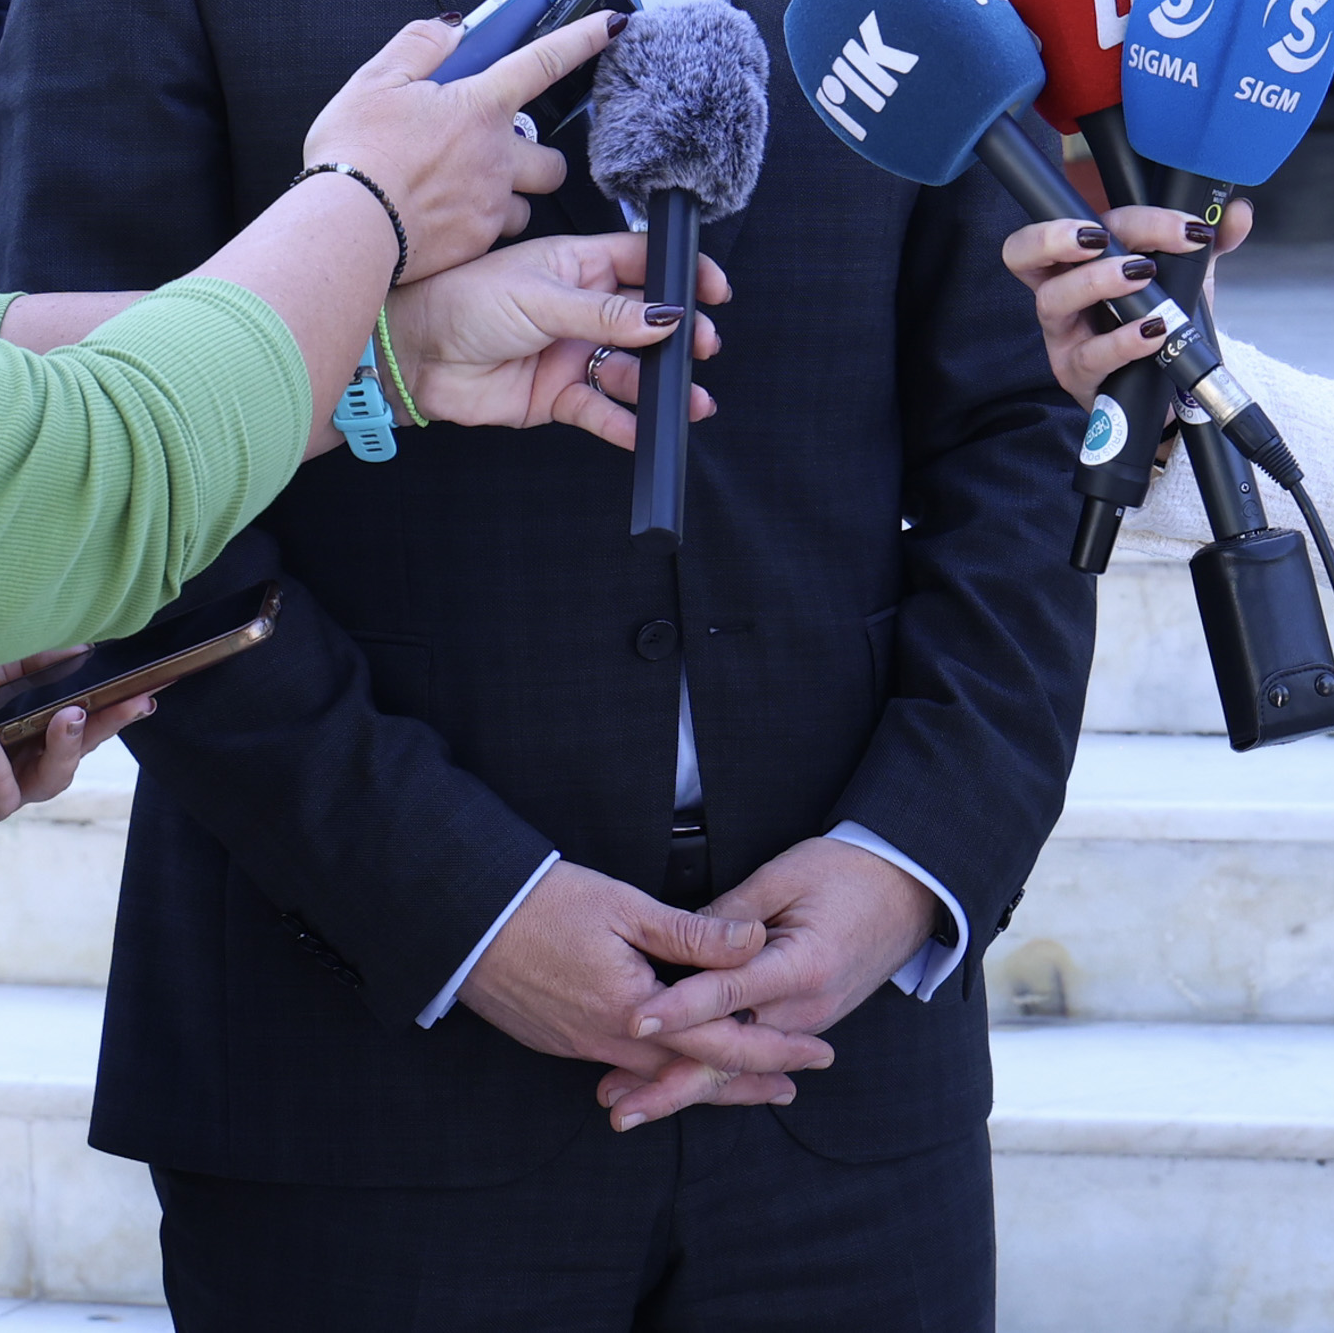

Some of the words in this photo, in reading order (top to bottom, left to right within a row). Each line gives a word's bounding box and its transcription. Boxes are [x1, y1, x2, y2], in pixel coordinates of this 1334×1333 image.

[1128, 43, 1199, 88] SIGMA
[1234, 76, 1301, 114] SIGM
[1103, 413, 1123, 456] CYPRUS
